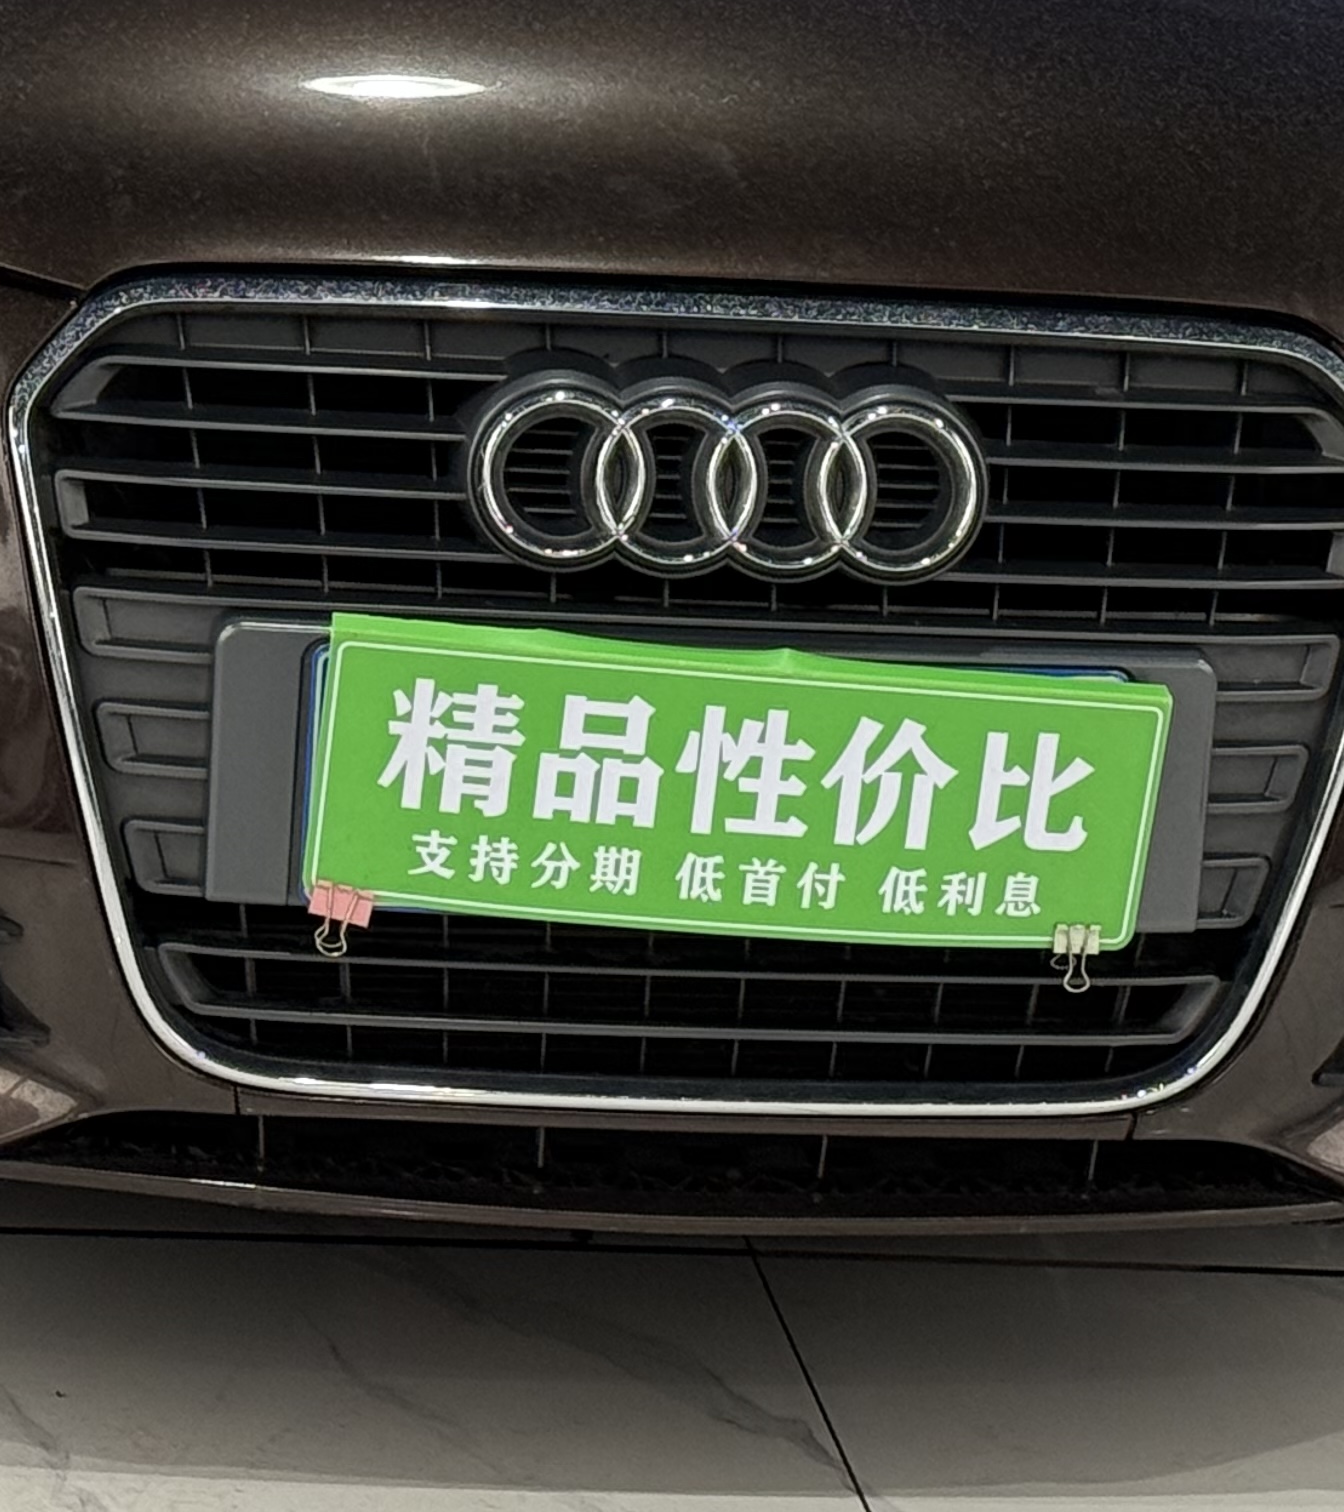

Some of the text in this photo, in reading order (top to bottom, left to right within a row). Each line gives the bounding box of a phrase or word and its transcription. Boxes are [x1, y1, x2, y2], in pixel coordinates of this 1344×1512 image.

[377, 677, 1096, 852] 精品性价比
[408, 829, 1042, 918] 支持分期 低首付 低利息
